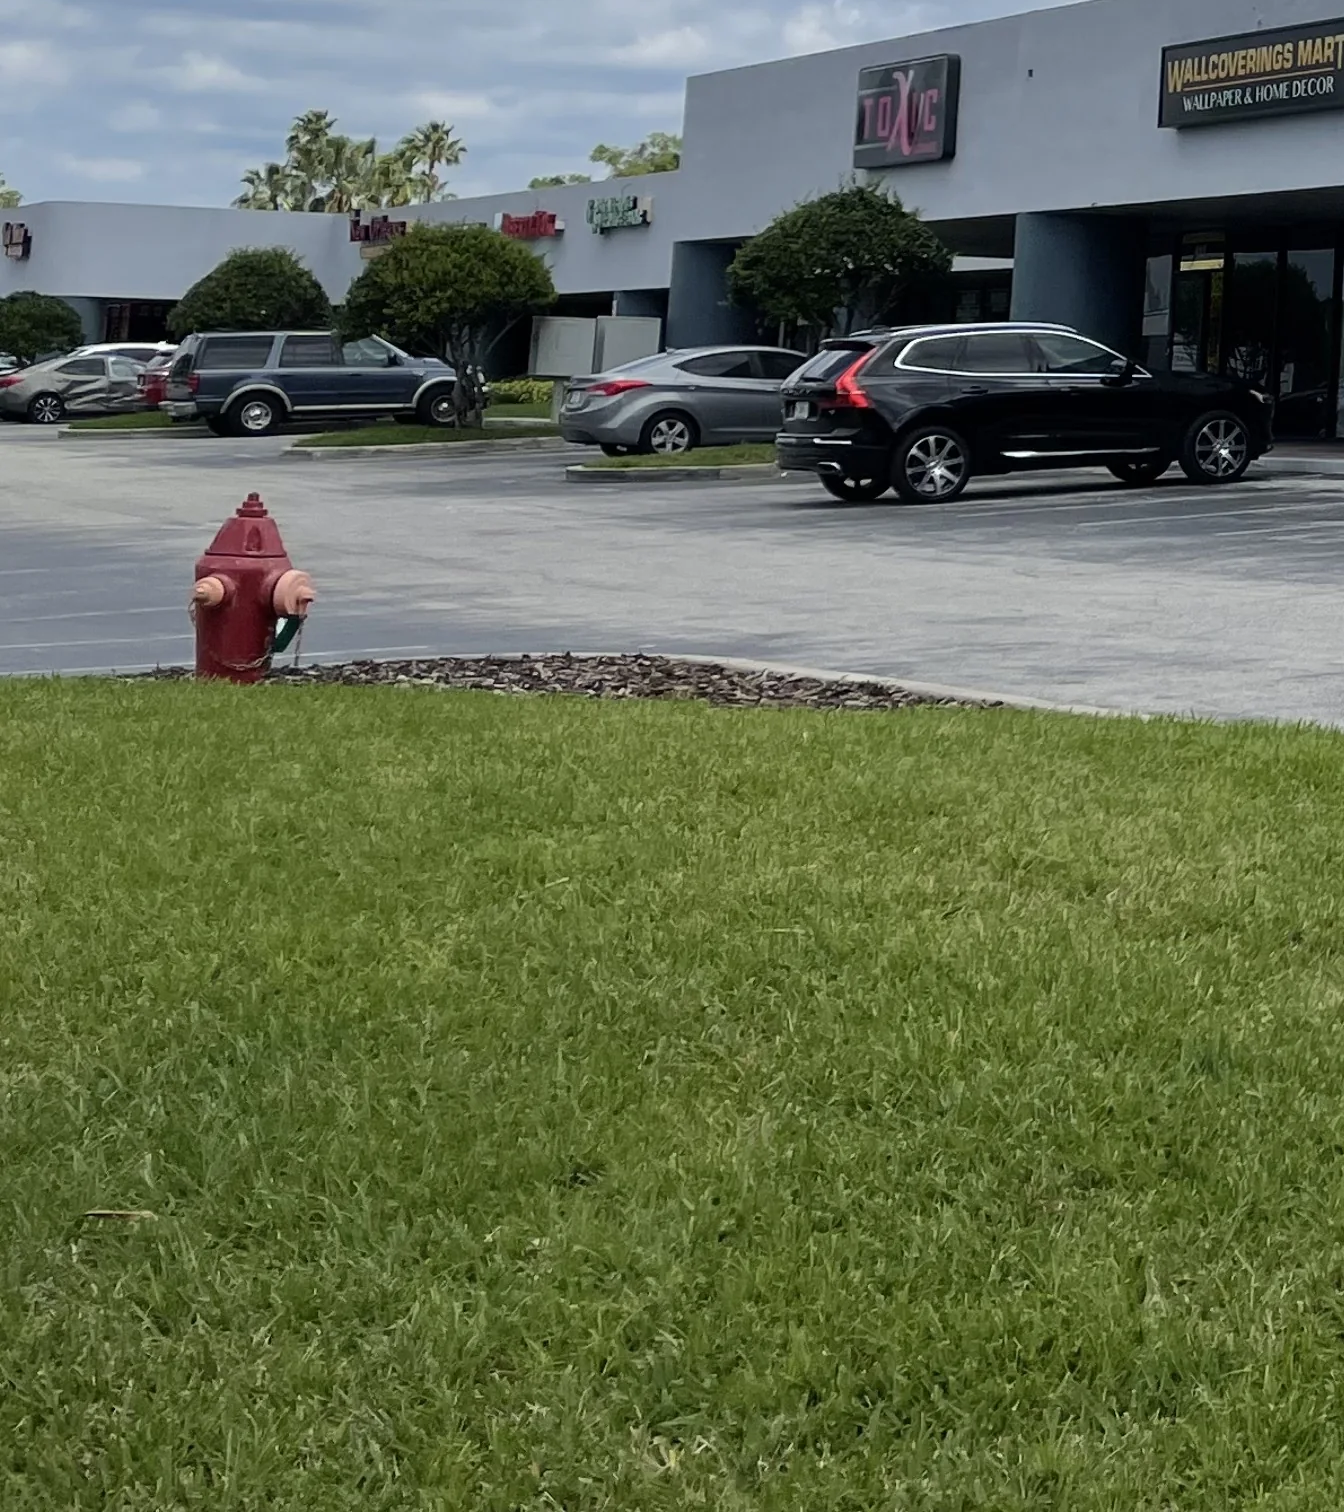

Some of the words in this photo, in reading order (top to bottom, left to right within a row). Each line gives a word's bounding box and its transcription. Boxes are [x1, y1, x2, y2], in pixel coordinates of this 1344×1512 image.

[1167, 43, 1293, 93] WALLCOVERINGS
[1182, 88, 1242, 112] WALLPAPER
[1243, 91, 1253, 105] &
[1256, 83, 1290, 103] HOME
[1292, 75, 1335, 98] DECOR
